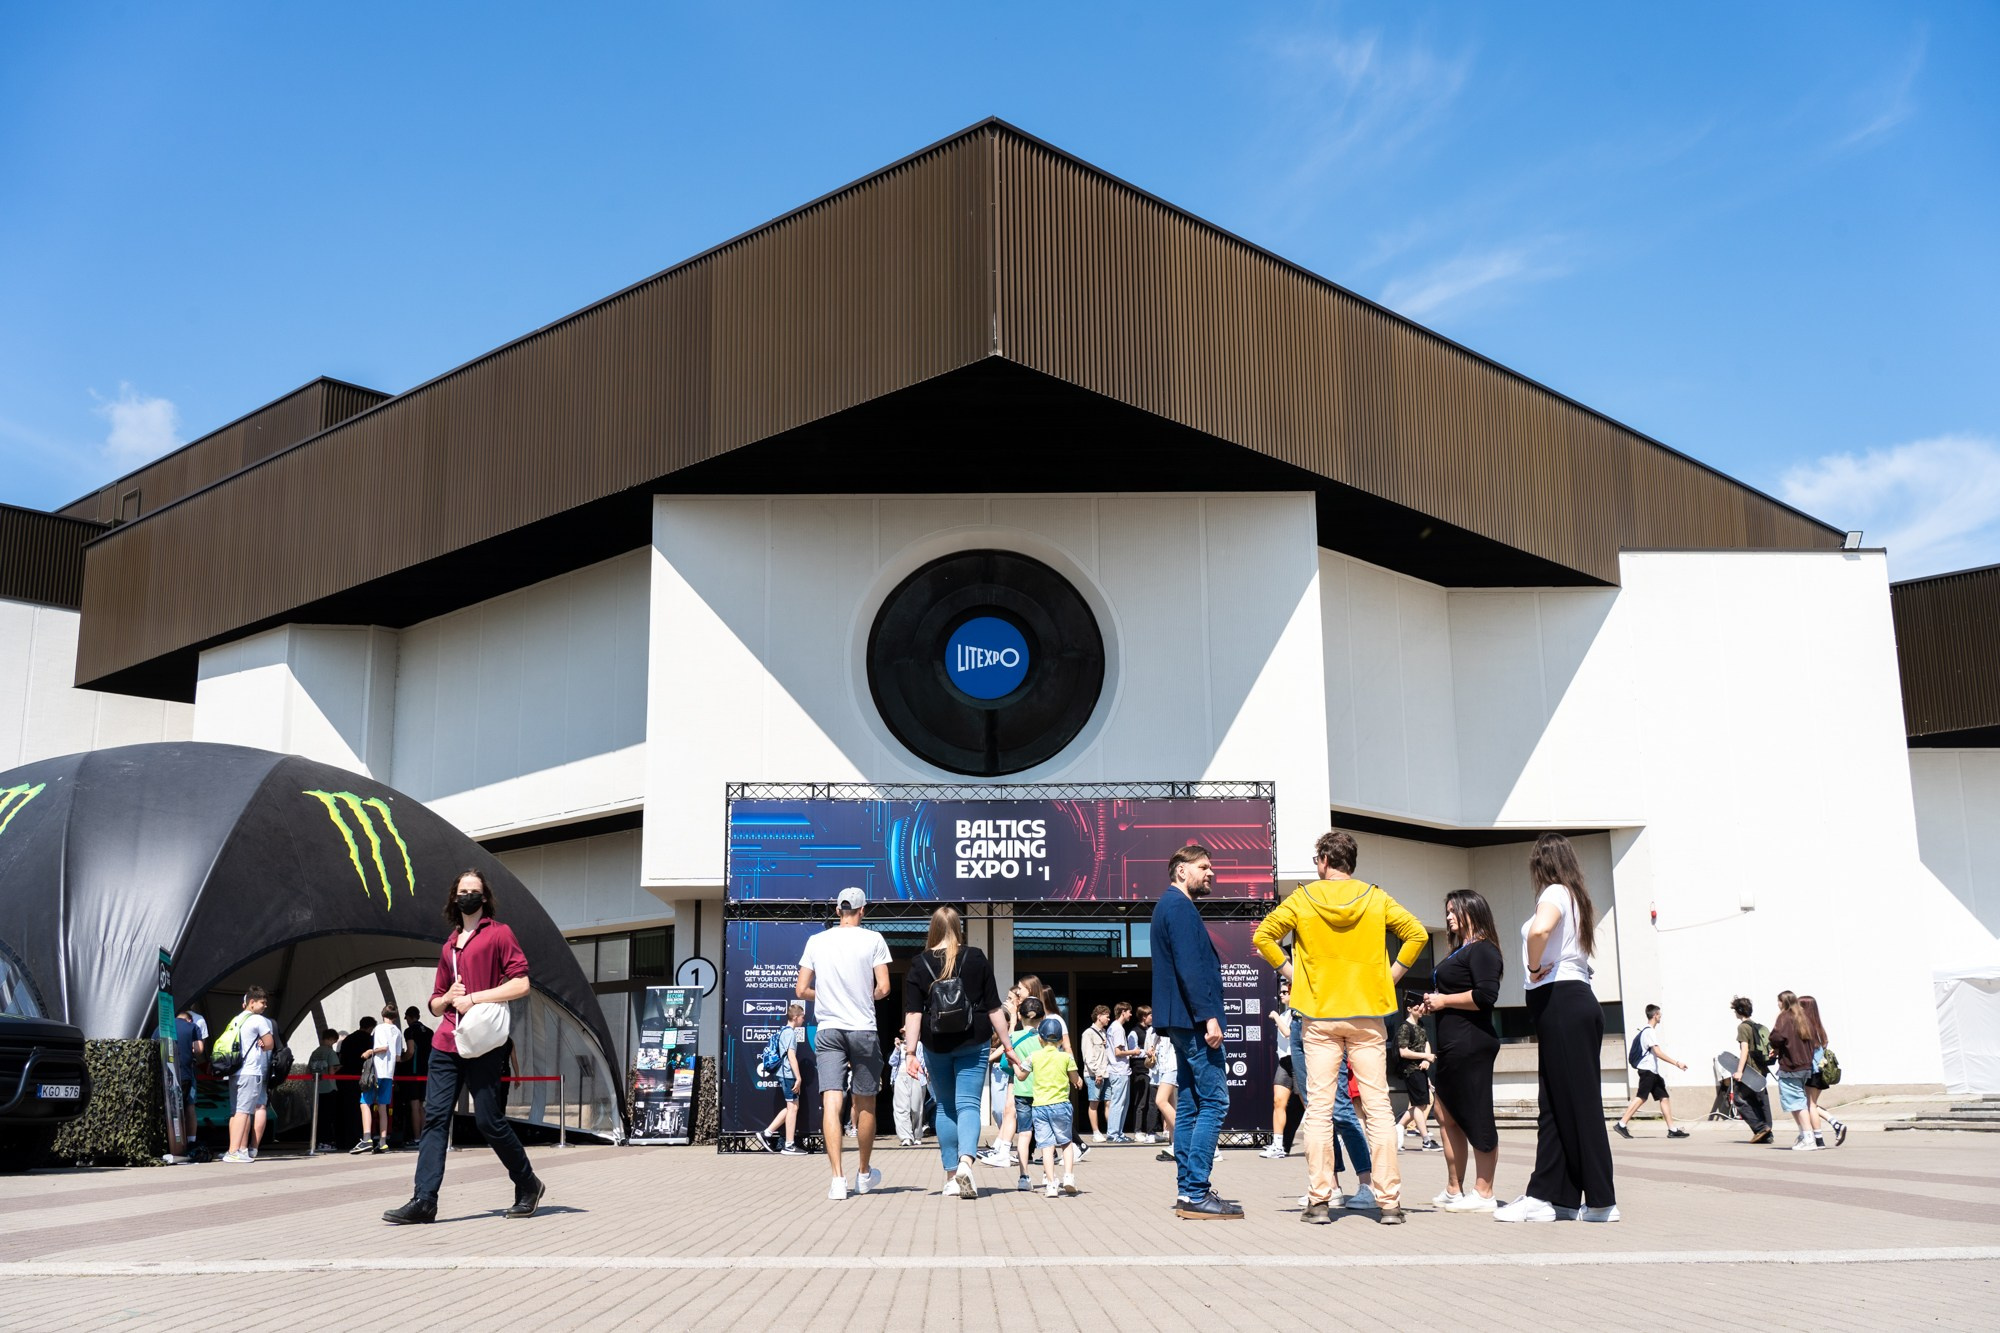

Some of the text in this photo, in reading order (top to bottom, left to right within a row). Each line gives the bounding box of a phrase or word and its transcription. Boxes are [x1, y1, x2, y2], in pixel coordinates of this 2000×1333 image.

[957, 643, 1020, 672] LITEXPO
[956, 819, 1047, 839] BALTICS
[955, 839, 1047, 859] GAMING
[956, 859, 1020, 879] EXPO
[691, 967, 699, 986] 1
[756, 1004, 786, 1012] Google Play
[753, 1032, 766, 1040] App
[1223, 1031, 1240, 1039] Store
[42, 1086, 60, 1097] KGO
[64, 1086, 79, 1097] 576
